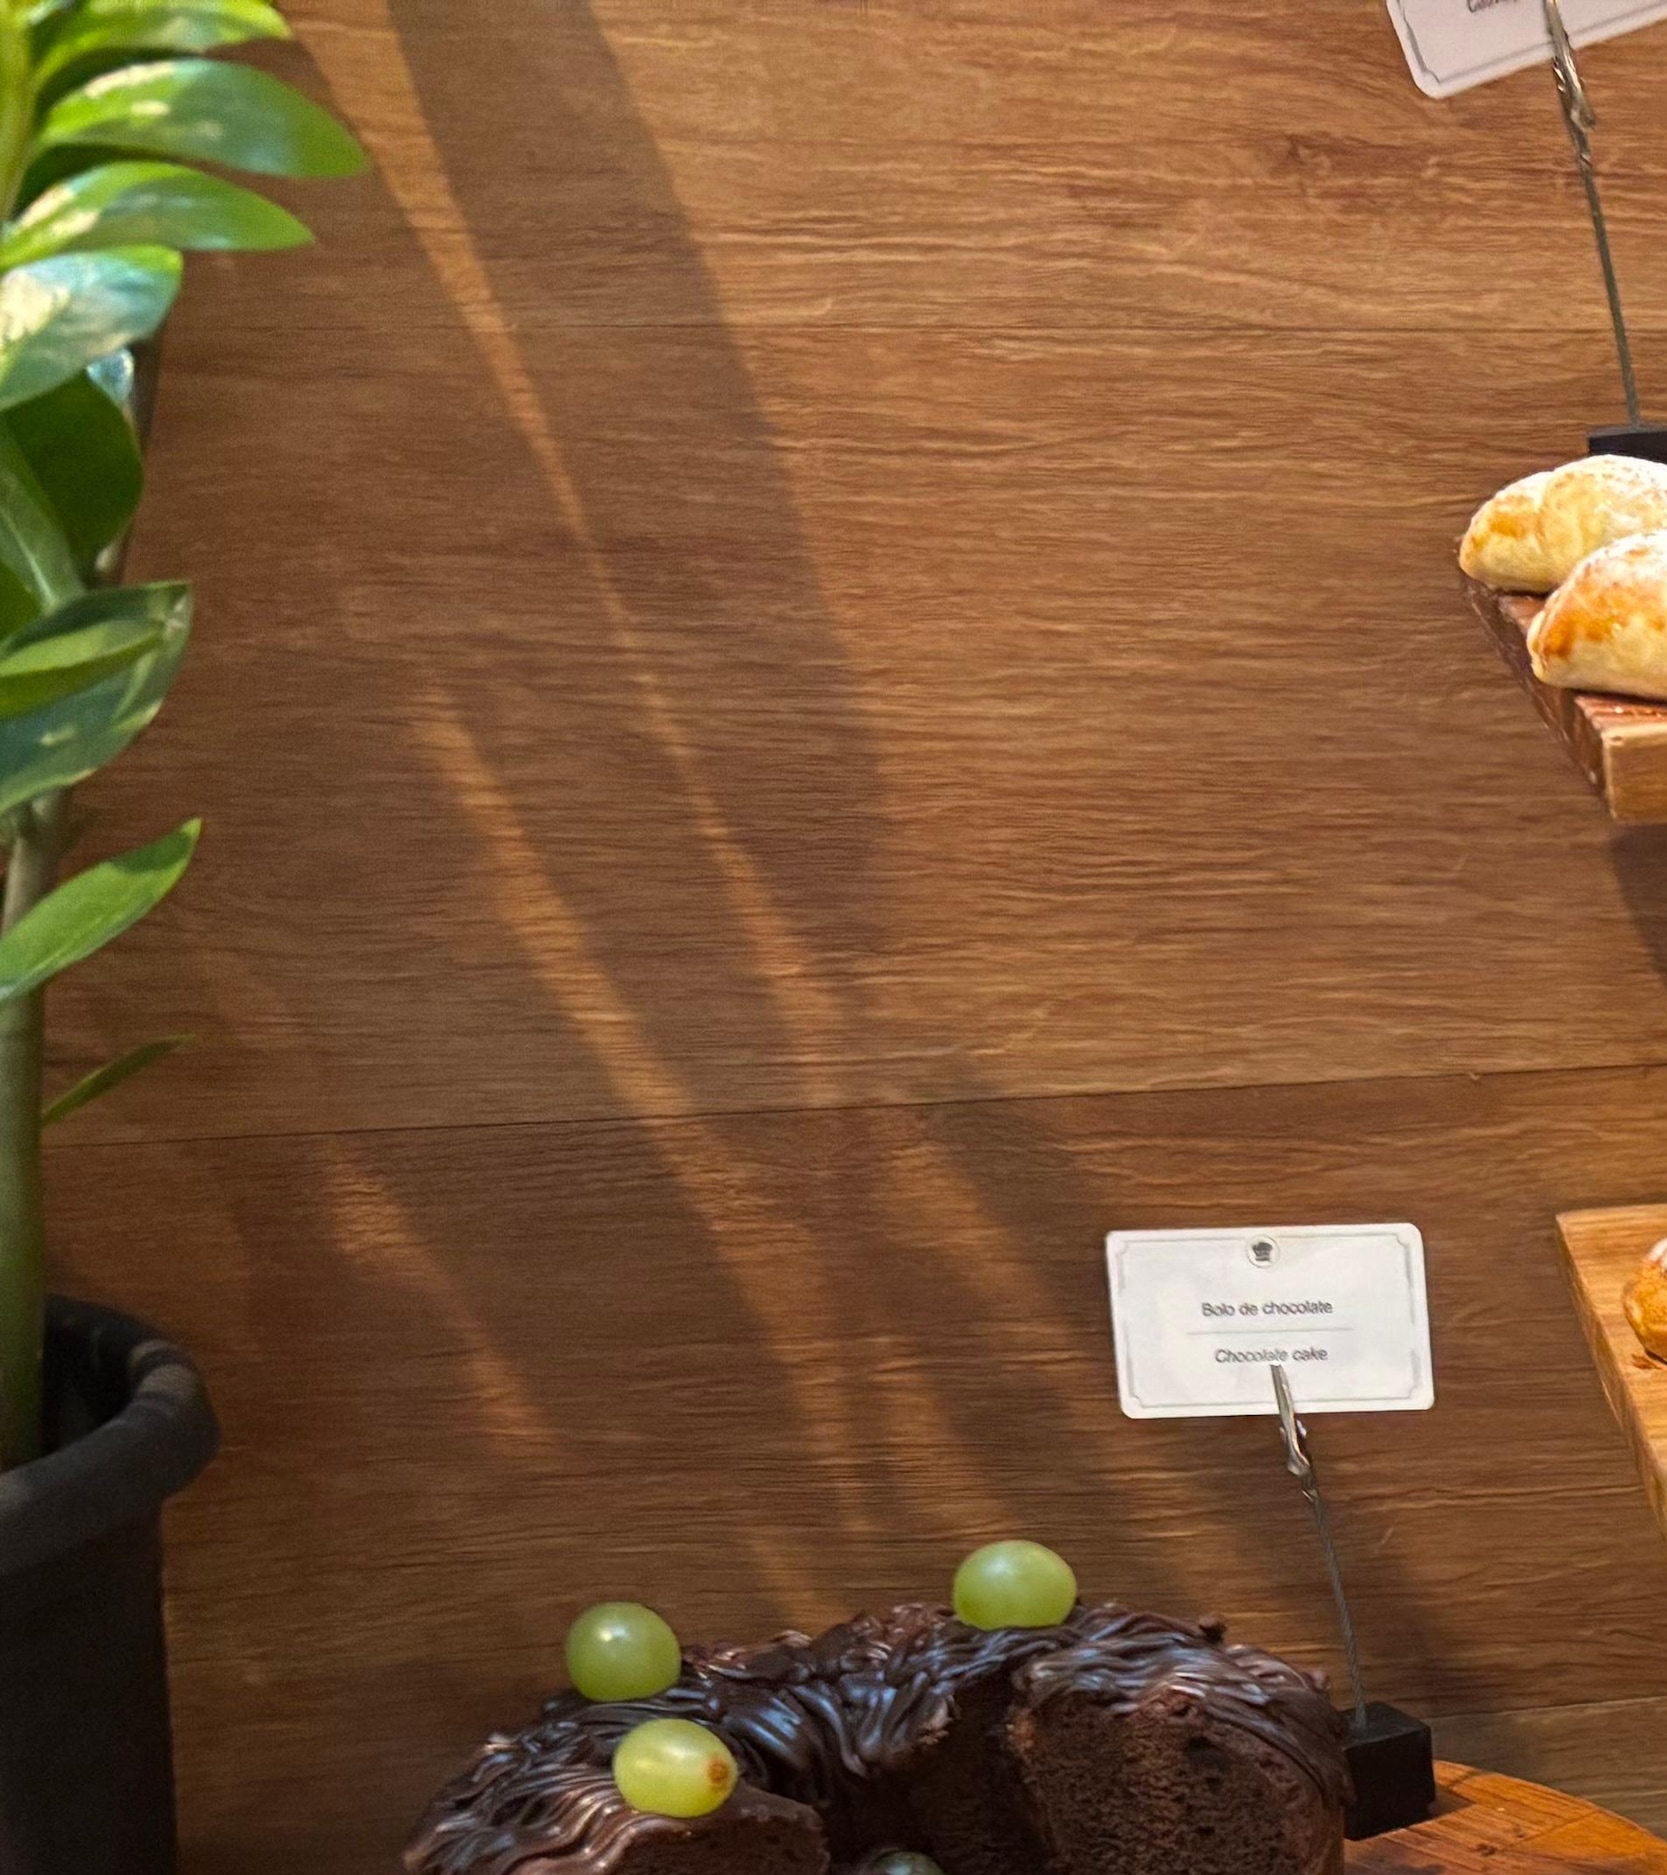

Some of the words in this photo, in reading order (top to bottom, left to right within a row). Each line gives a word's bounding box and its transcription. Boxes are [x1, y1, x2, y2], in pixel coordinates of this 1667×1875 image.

[1202, 1302, 1236, 1317] Bolo
[1239, 1302, 1258, 1316] de
[1262, 1300, 1333, 1316] chocolate
[1215, 1348, 1288, 1363] Chocolate
[1291, 1347, 1328, 1362] cake
